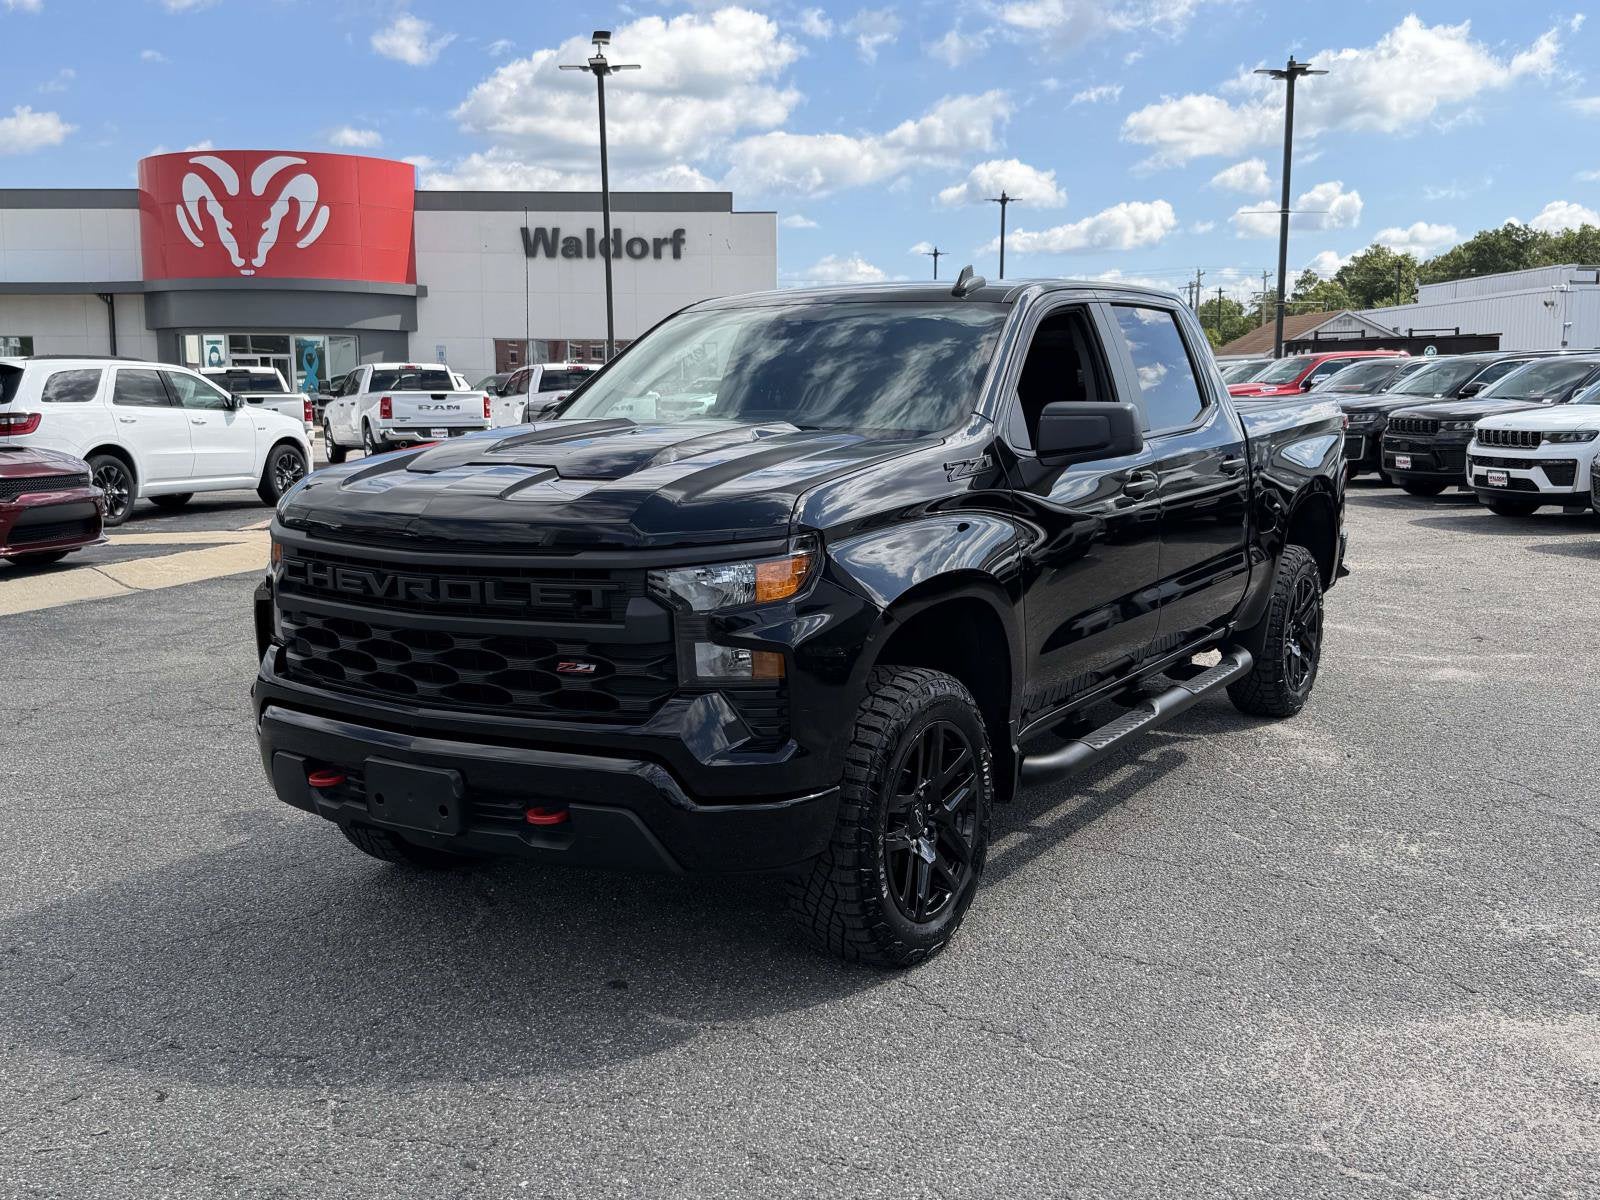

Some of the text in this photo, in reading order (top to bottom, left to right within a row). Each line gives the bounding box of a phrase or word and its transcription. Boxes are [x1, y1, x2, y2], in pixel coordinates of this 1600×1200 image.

[520, 227, 686, 259] Waldorf
[943, 454, 993, 482] Z71
[283, 558, 619, 608] CHEVROLET
[556, 662, 597, 673] Z71
